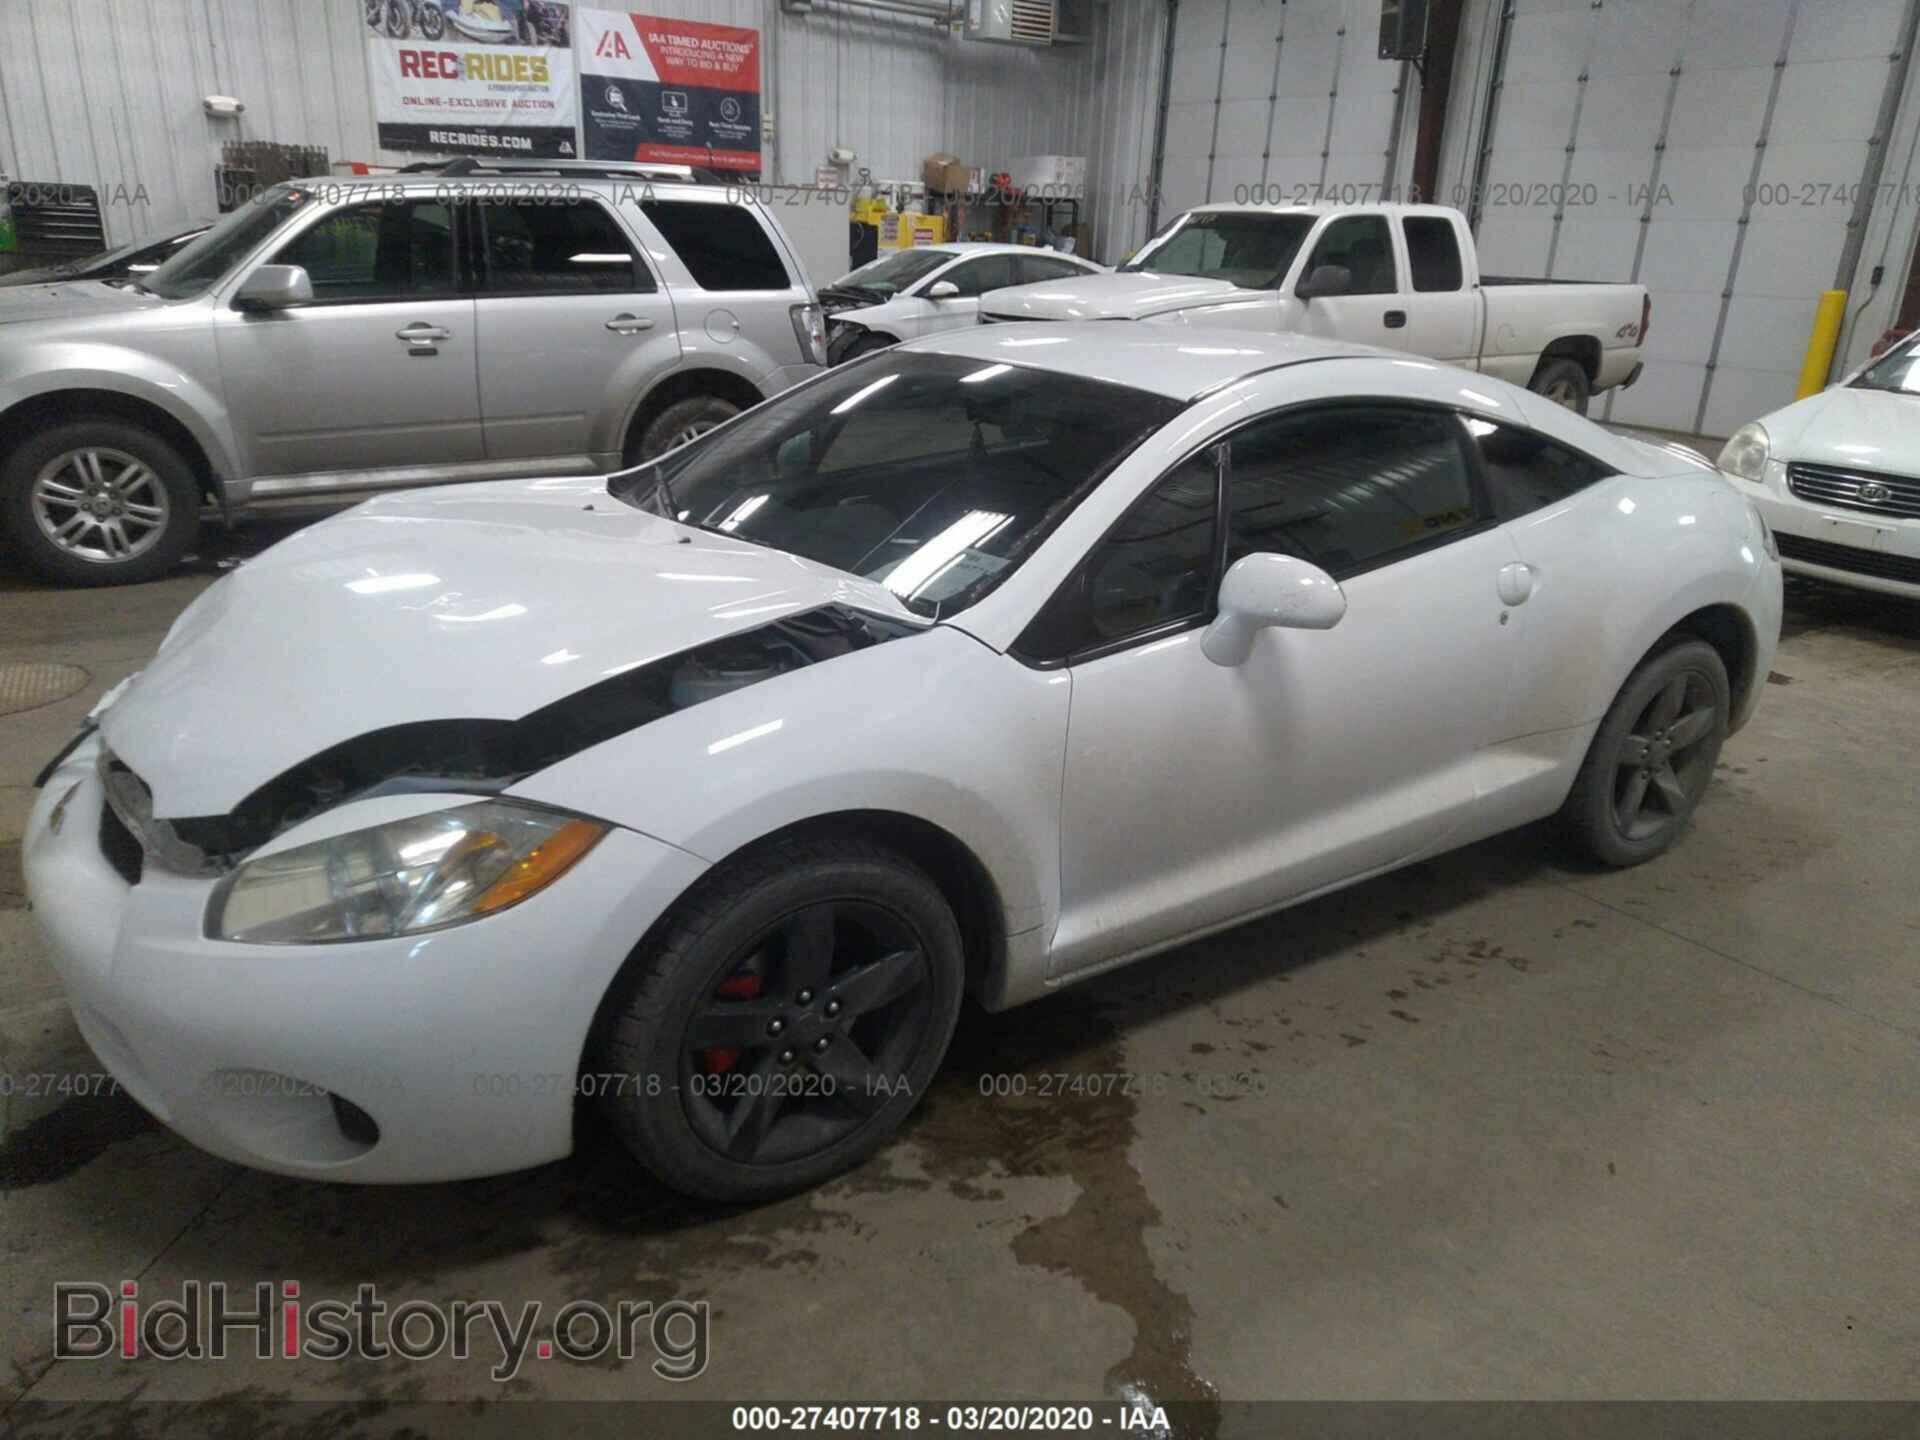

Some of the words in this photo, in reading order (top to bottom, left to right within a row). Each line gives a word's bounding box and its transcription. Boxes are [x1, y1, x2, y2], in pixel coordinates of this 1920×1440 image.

[666, 34, 699, 47] TIMED
[399, 49, 459, 79] REC
[463, 52, 549, 83] RIDES
[512, 99, 555, 109] AUCTION
[429, 130, 532, 150] RECRIDES.COM
